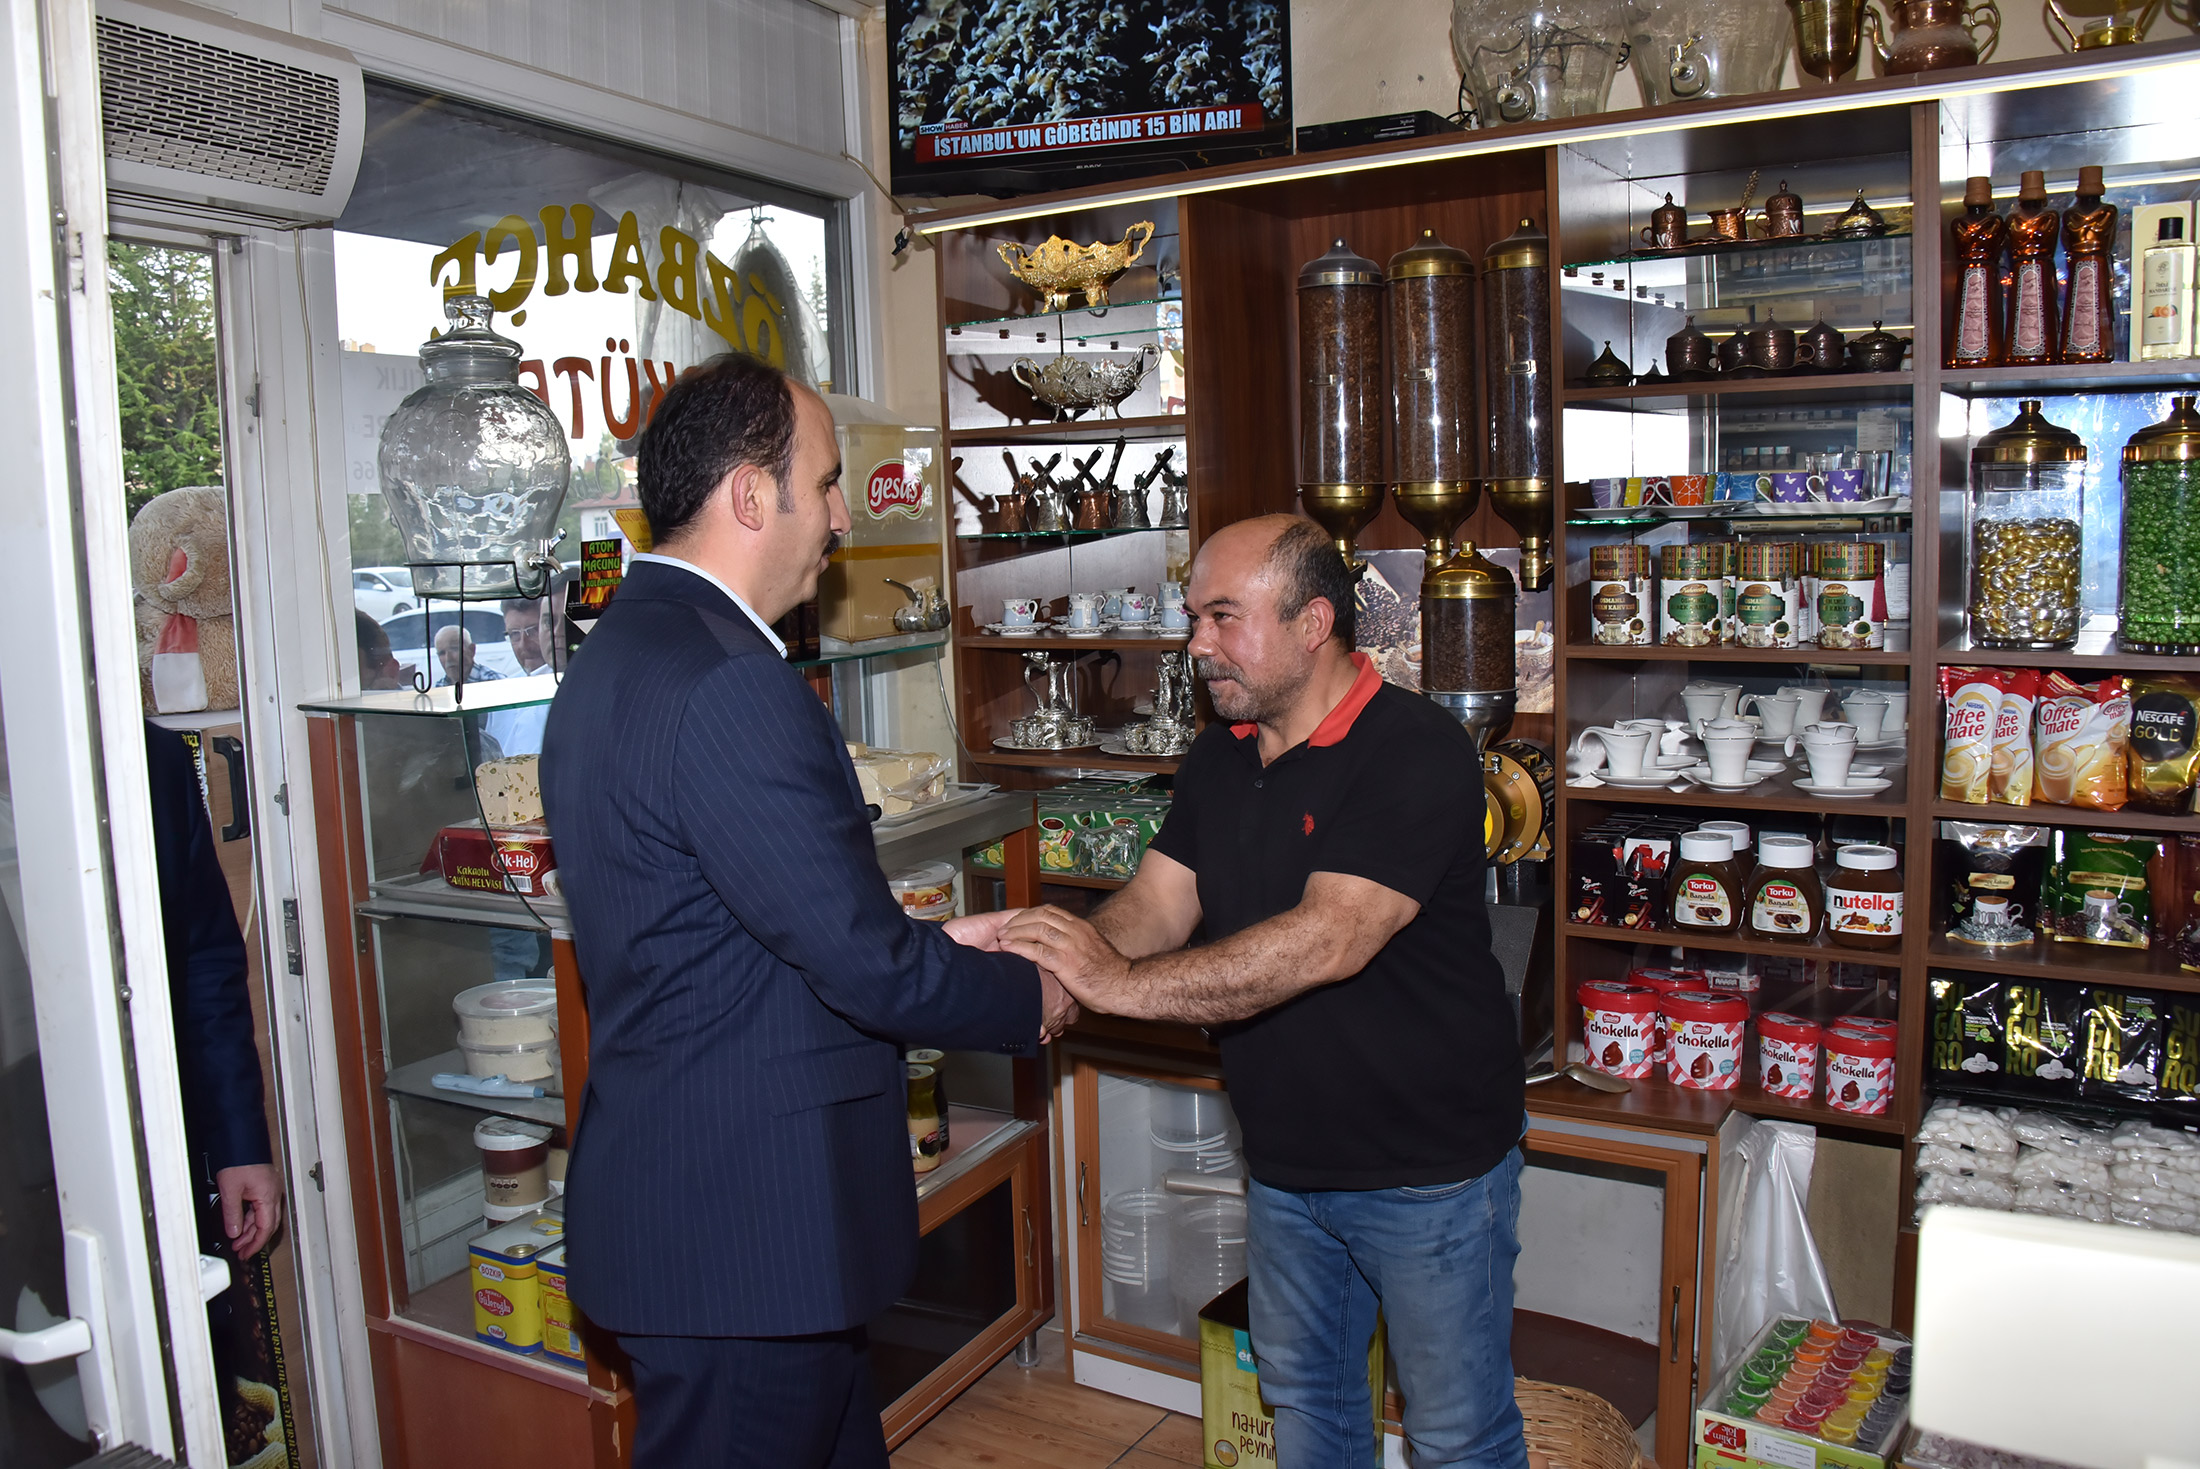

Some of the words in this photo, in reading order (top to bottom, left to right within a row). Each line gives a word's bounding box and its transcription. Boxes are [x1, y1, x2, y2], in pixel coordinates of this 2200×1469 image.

[920, 125, 944, 134] SHOW
[945, 122, 969, 131] HABER
[934, 129, 1041, 157] İSTANBUL'UN
[1044, 117, 1142, 146] GÖBEĞİNDE
[1144, 116, 1166, 137] 15
[1169, 111, 1201, 135] BİN
[1204, 109, 1242, 131] ARI!
[589, 540, 615, 555] ATOM
[583, 558, 621, 572] MACUNU
[2038, 701, 2081, 725] Coffee
[1947, 723, 1985, 740] mate
[2045, 718, 2080, 735] mate
[2134, 725, 2182, 742] GOLD
[457, 866, 490, 876] Kakaolu
[1690, 881, 1714, 890] Torku
[1768, 888, 1794, 897] Torku
[1834, 895, 1895, 911] nutella
[1590, 1022, 1639, 1038] chokella
[1677, 1033, 1730, 1049] chokella
[1761, 1045, 1796, 1063] chokella
[1933, 1040, 1963, 1071] RO
[2005, 1046, 2037, 1077] RO
[1832, 1062, 1875, 1078] chokella
[2161, 1058, 2197, 1091] RO
[1712, 1432, 1737, 1446] Dilim
[1721, 1425, 1739, 1438] Jöle
